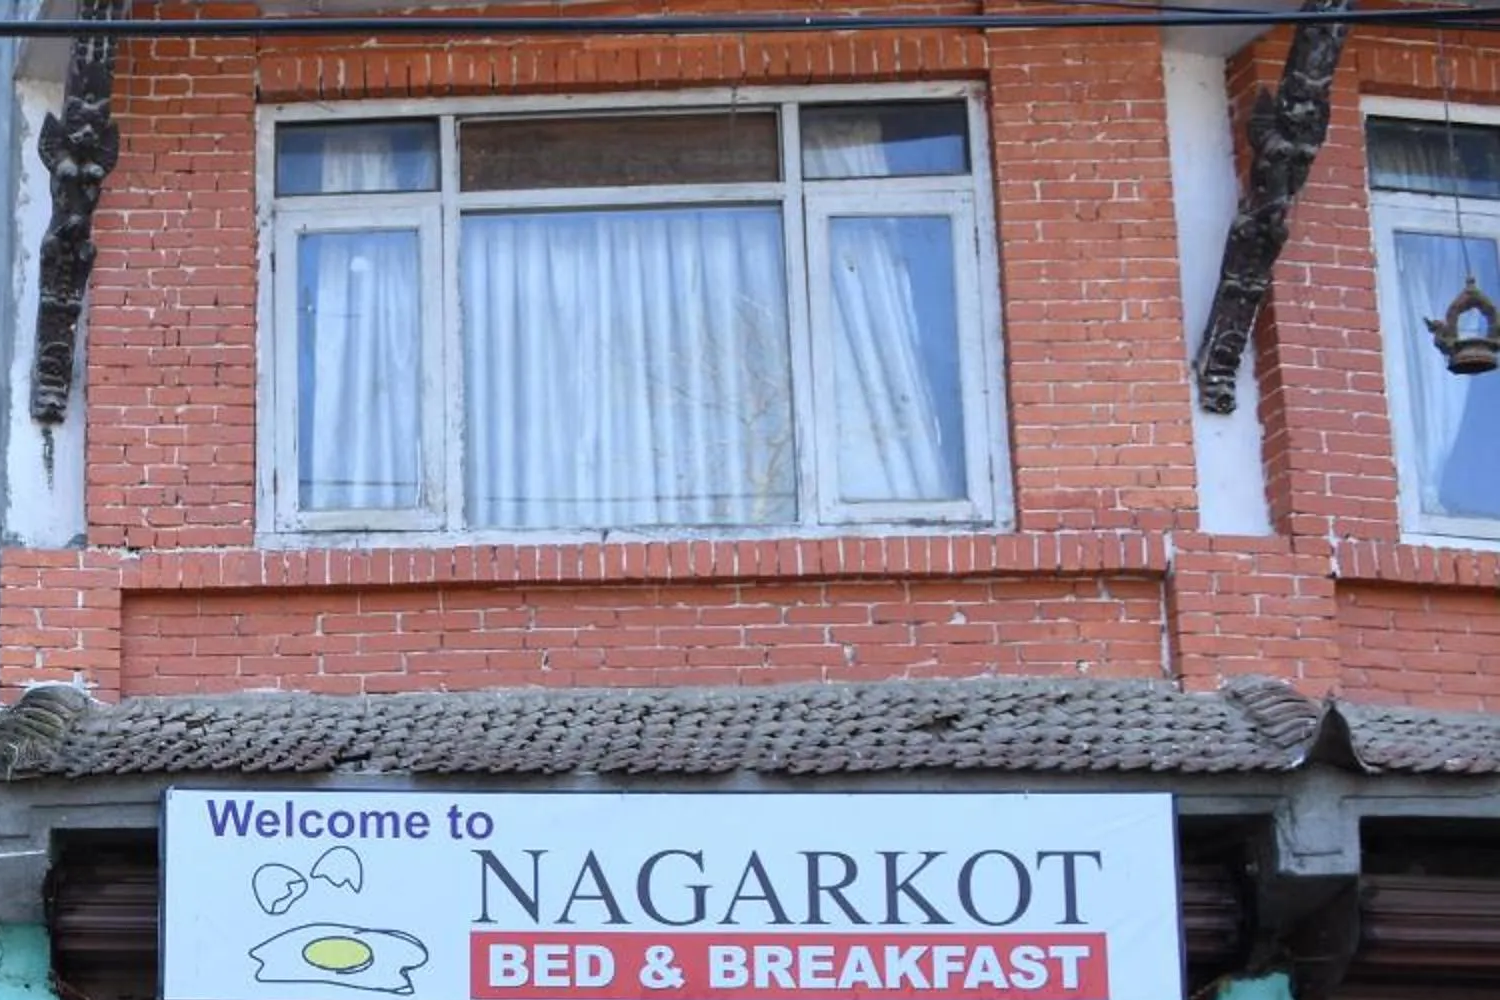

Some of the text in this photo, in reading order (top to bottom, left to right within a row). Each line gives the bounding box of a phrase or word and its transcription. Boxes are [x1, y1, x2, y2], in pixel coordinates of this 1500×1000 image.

[206, 799, 495, 841] Welcome to
[470, 848, 1103, 927] NAGARKOT
[488, 943, 1090, 991] BED & BREAKFAST
